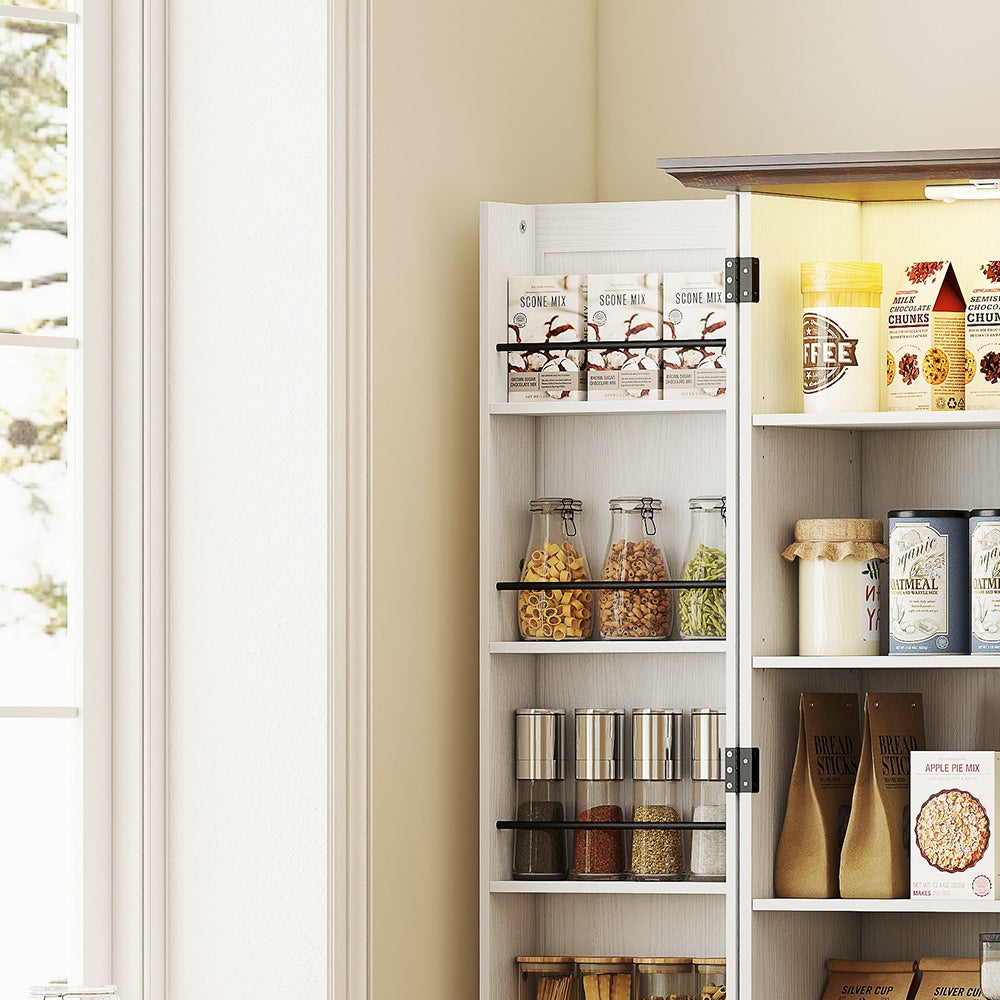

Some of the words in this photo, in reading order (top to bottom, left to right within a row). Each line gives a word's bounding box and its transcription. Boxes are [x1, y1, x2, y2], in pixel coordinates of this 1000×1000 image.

[520, 296, 547, 308] SCONE
[551, 296, 566, 307] MIX
[600, 294, 627, 306] SCONE
[631, 294, 646, 305] MIX
[676, 292, 703, 304] SCONE
[707, 292, 722, 303] MIX
[892, 296, 916, 304] MILK
[890, 305, 931, 313] CHOCOLATE
[889, 313, 929, 324] CHUNKS
[814, 735, 853, 755] BREAD
[817, 756, 858, 775] STICKS
[882, 756, 910, 776] STIC
[925, 764, 949, 772] APPLE
[952, 764, 963, 772] PIE
[966, 764, 980, 772] MIX
[842, 986, 872, 994] SILVER
[874, 986, 894, 995] CUP
[934, 987, 965, 996] SILVER
